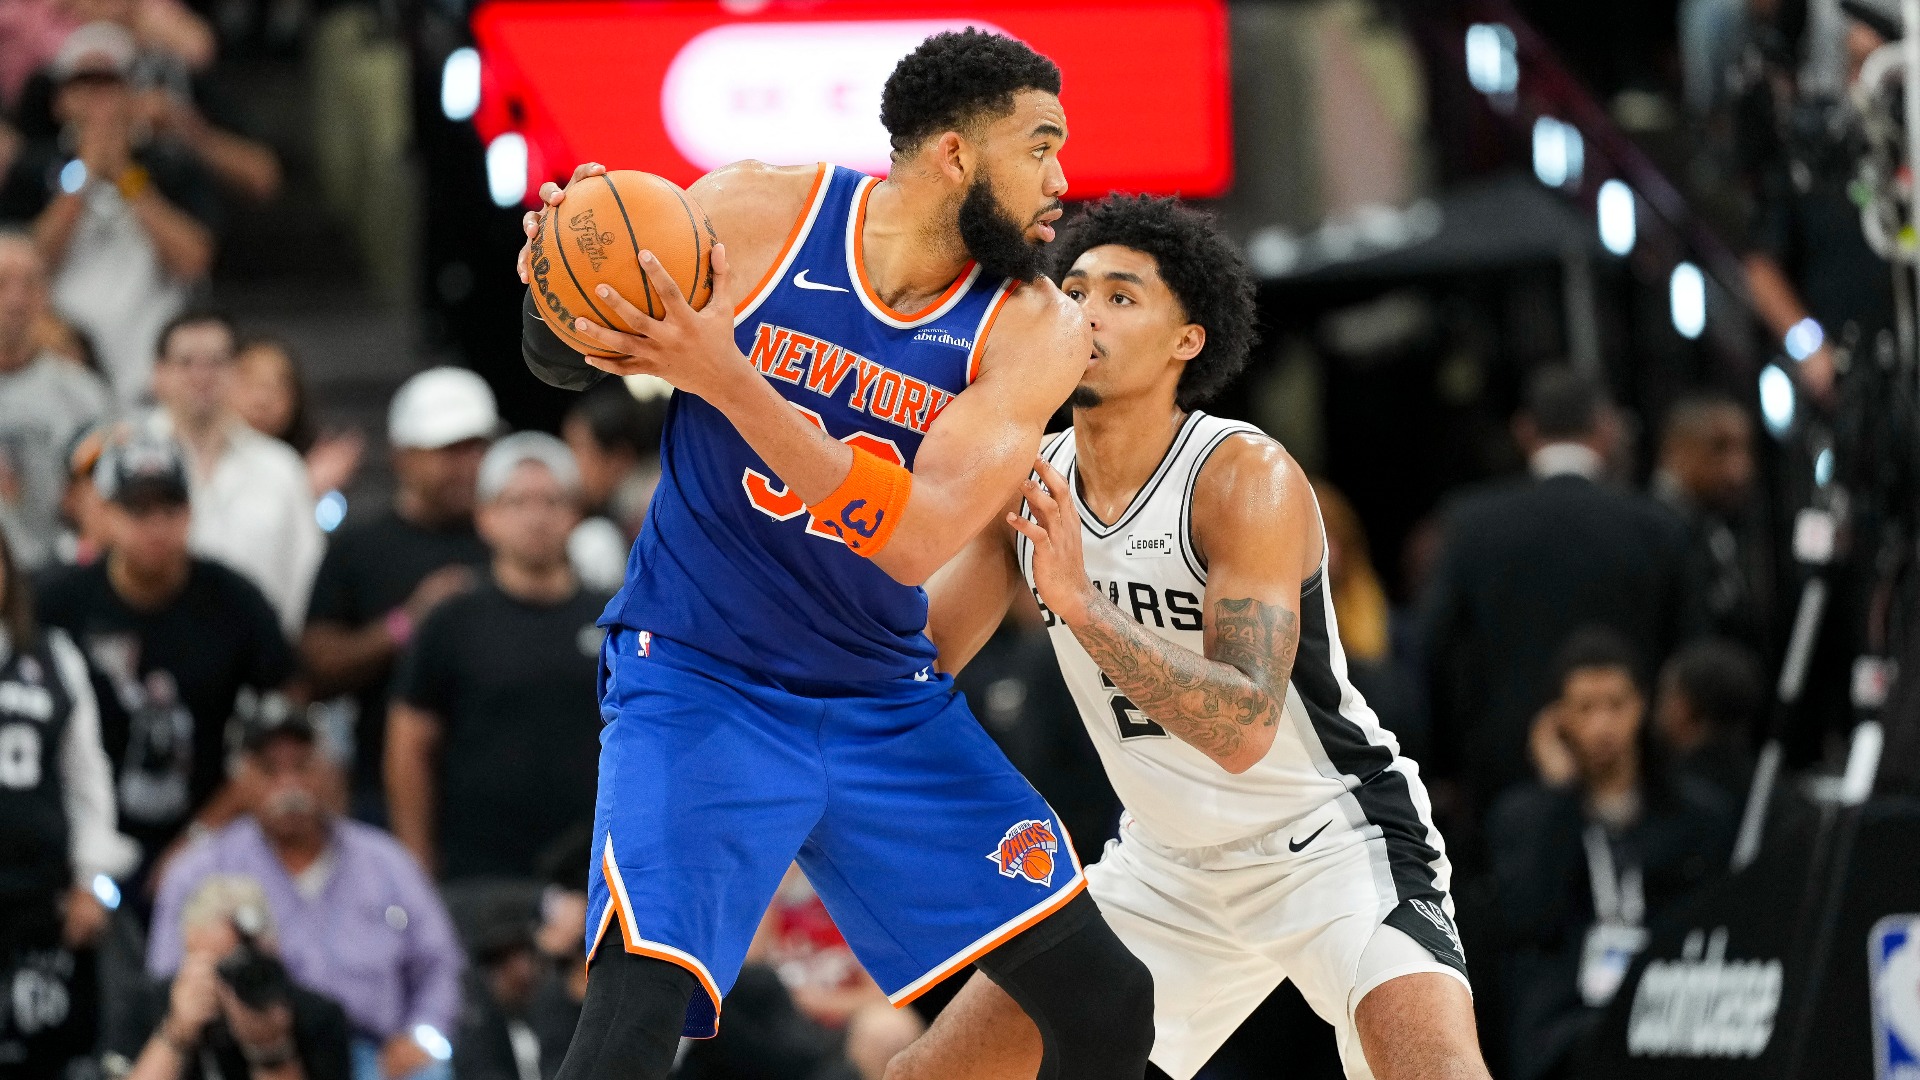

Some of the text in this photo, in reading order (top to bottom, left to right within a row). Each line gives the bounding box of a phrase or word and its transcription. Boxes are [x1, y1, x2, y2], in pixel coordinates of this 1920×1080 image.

[913, 332, 973, 350] abu dhabi
[748, 321, 957, 435] NEW YORK
[1131, 539, 1165, 550] LEDGER
[1032, 580, 1203, 631] SRS
[1223, 624, 1255, 644] 24
[1001, 822, 1056, 872] KNICKS
